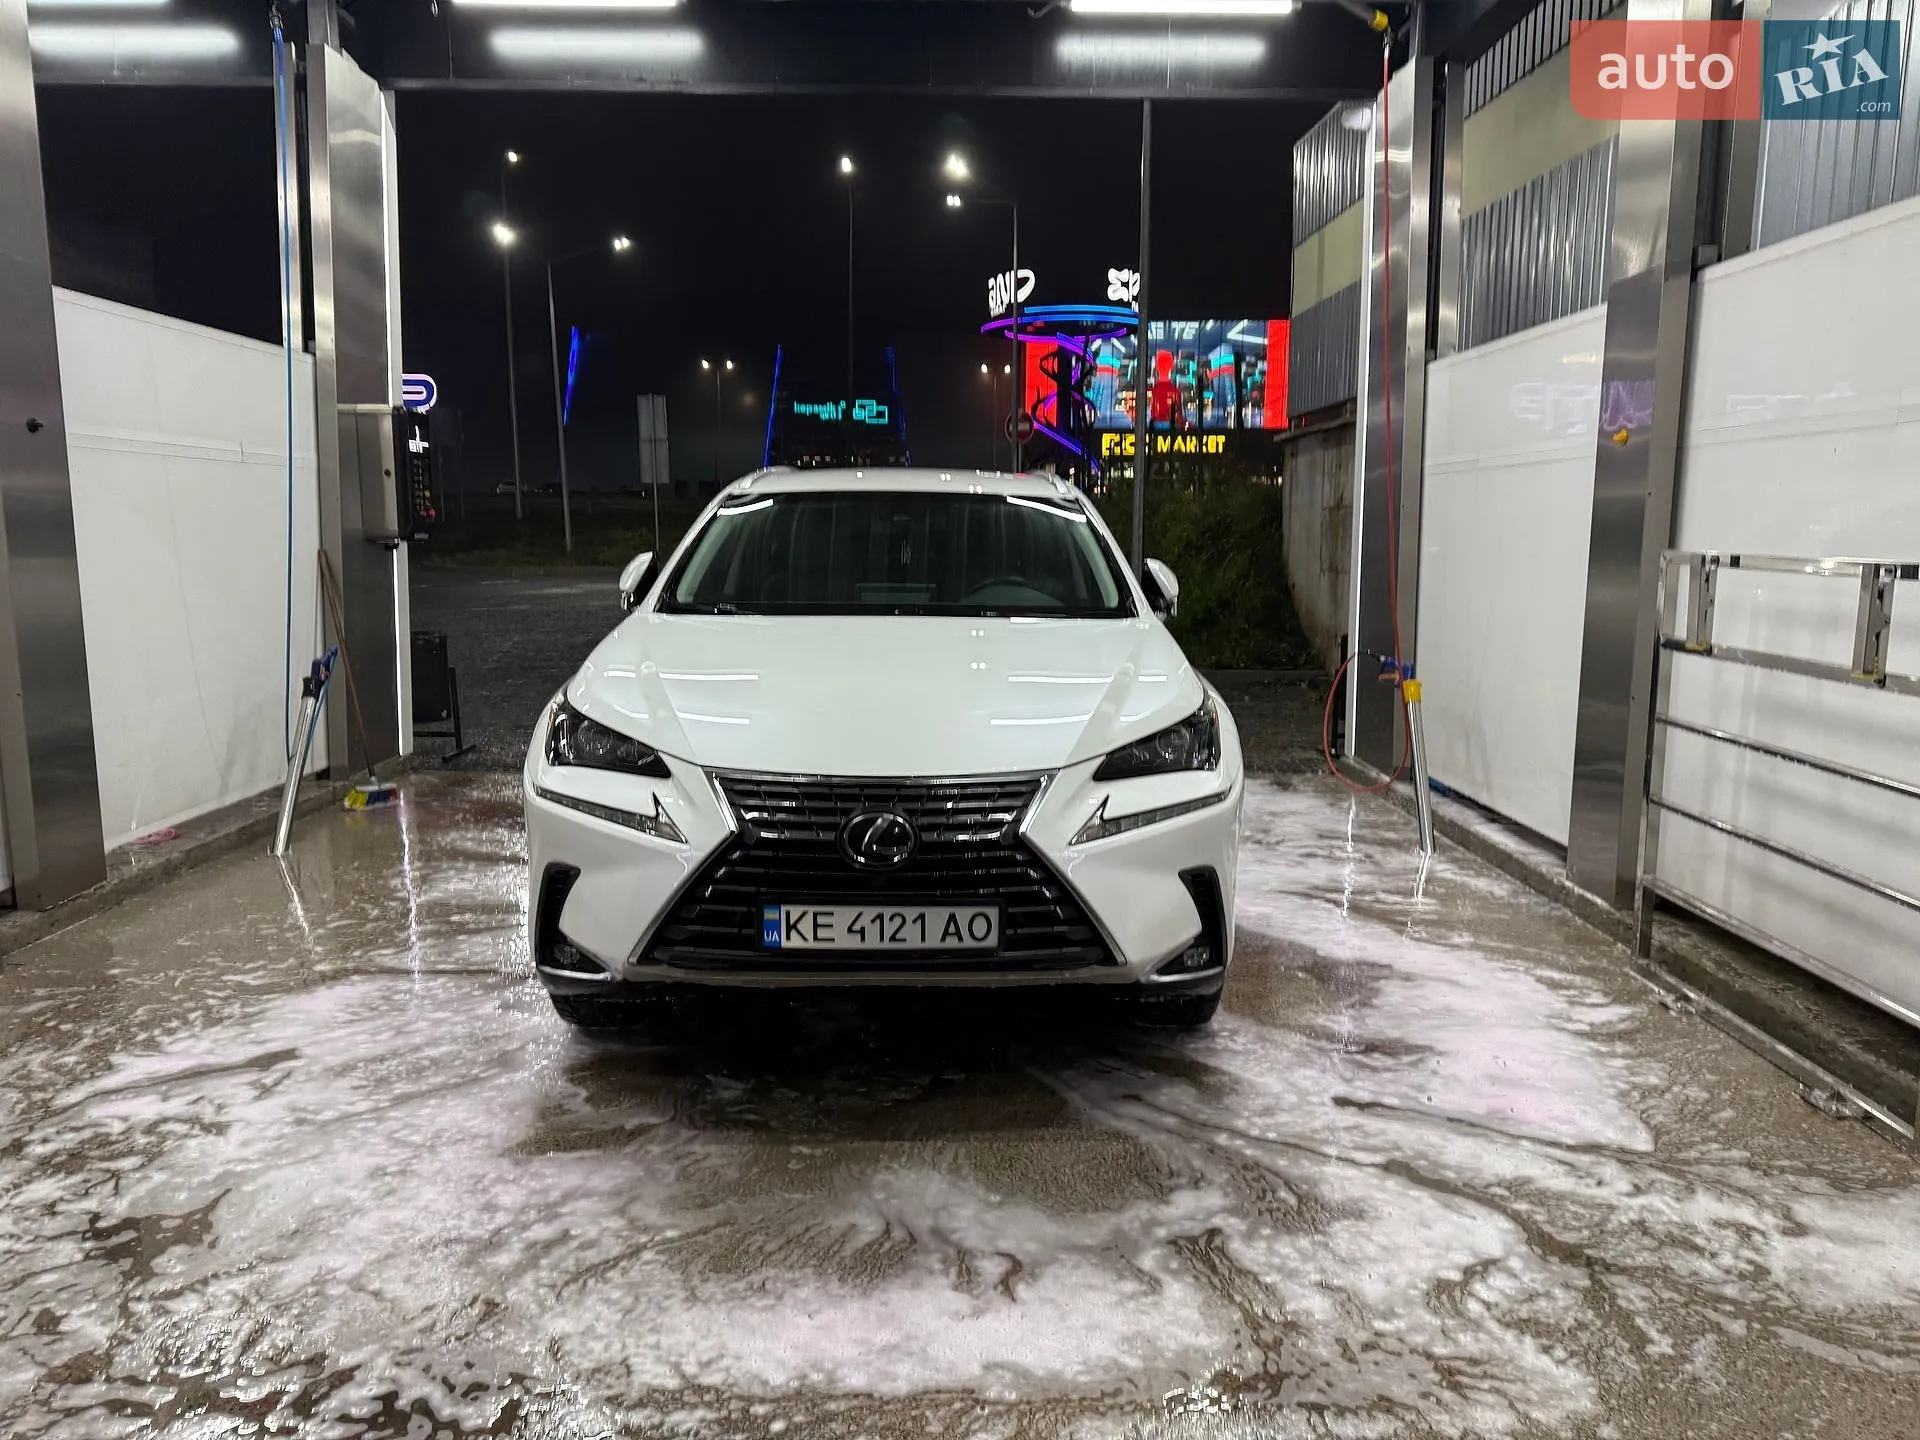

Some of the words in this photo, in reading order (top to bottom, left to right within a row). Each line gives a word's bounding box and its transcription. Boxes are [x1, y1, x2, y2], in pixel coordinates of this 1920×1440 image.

[764, 931, 780, 943] UA
[784, 910, 836, 943] KE
[846, 911, 927, 943] 4121
[939, 911, 993, 944] AO
